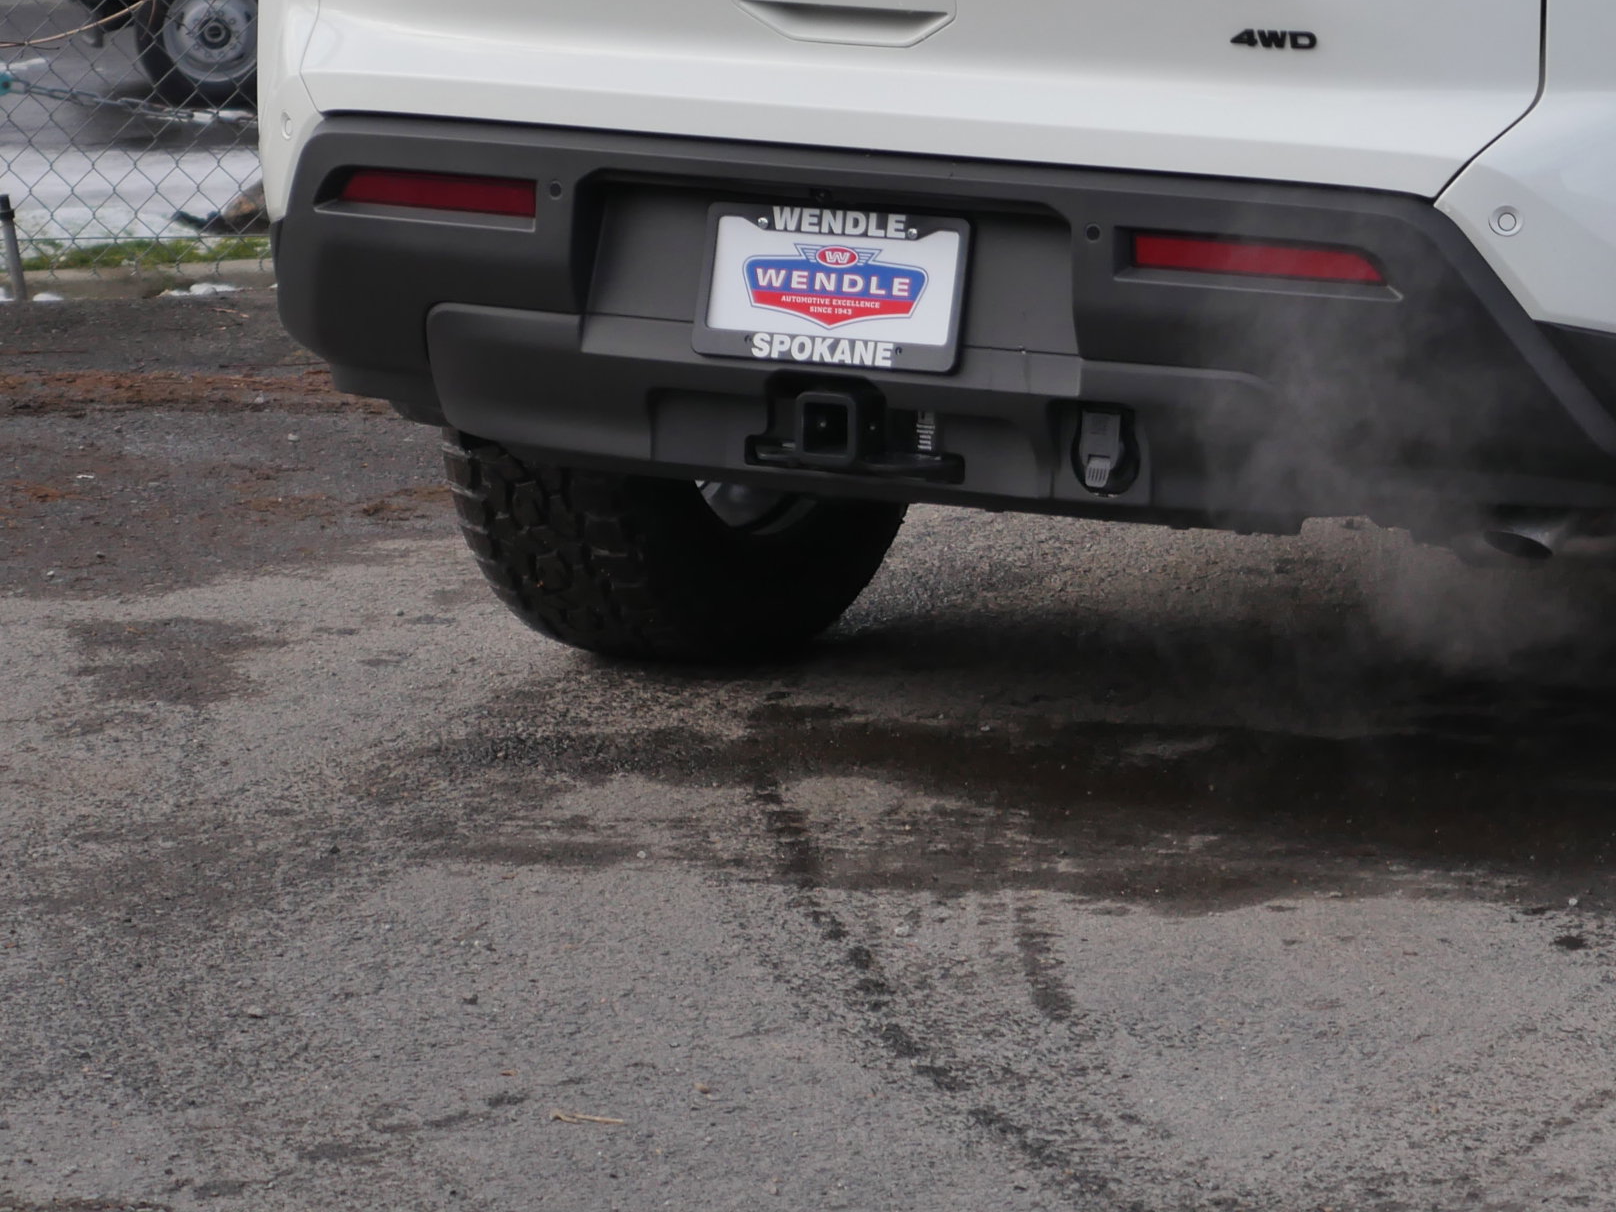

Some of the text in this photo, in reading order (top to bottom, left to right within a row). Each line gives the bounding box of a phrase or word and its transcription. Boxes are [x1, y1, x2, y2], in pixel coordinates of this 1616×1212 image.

[1230, 28, 1318, 51] 4WD
[773, 206, 906, 238] WENDLE
[755, 267, 911, 297] WENDLE
[780, 294, 881, 309] AUTOMOTIVE EXCELLENCE
[809, 305, 832, 314] SINCE
[750, 332, 894, 368] SPOKANE
